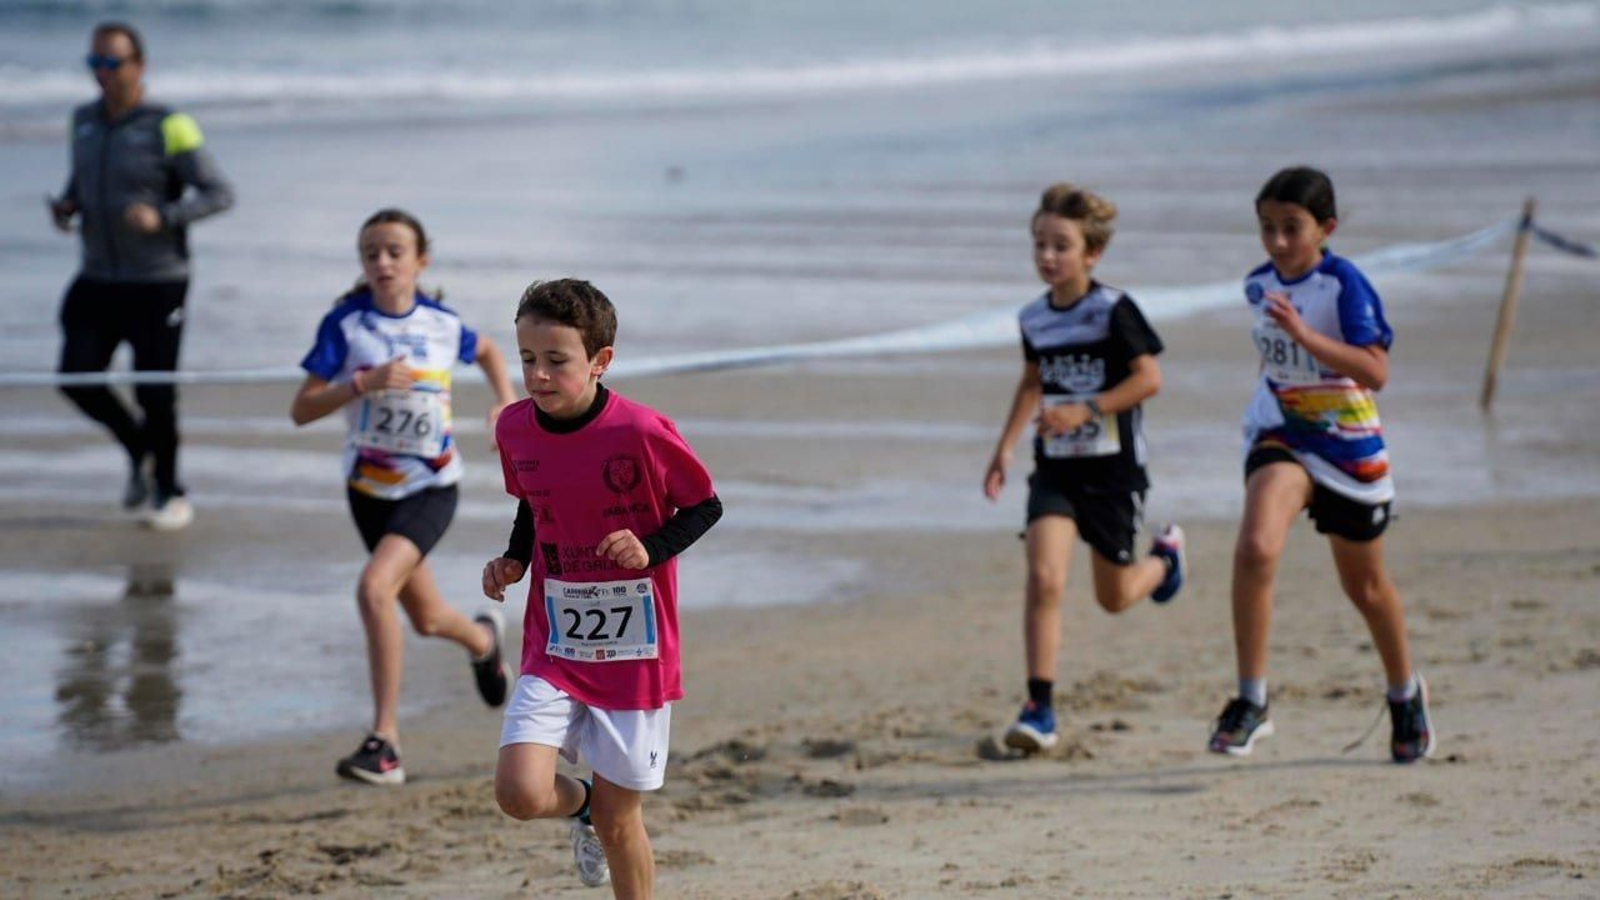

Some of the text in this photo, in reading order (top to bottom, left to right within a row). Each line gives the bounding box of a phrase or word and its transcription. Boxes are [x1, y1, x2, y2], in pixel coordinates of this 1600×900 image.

[1260, 337, 1299, 366] 281
[377, 406, 431, 437] 276
[563, 545, 597, 558] XUNT
[563, 606, 633, 641] 227
